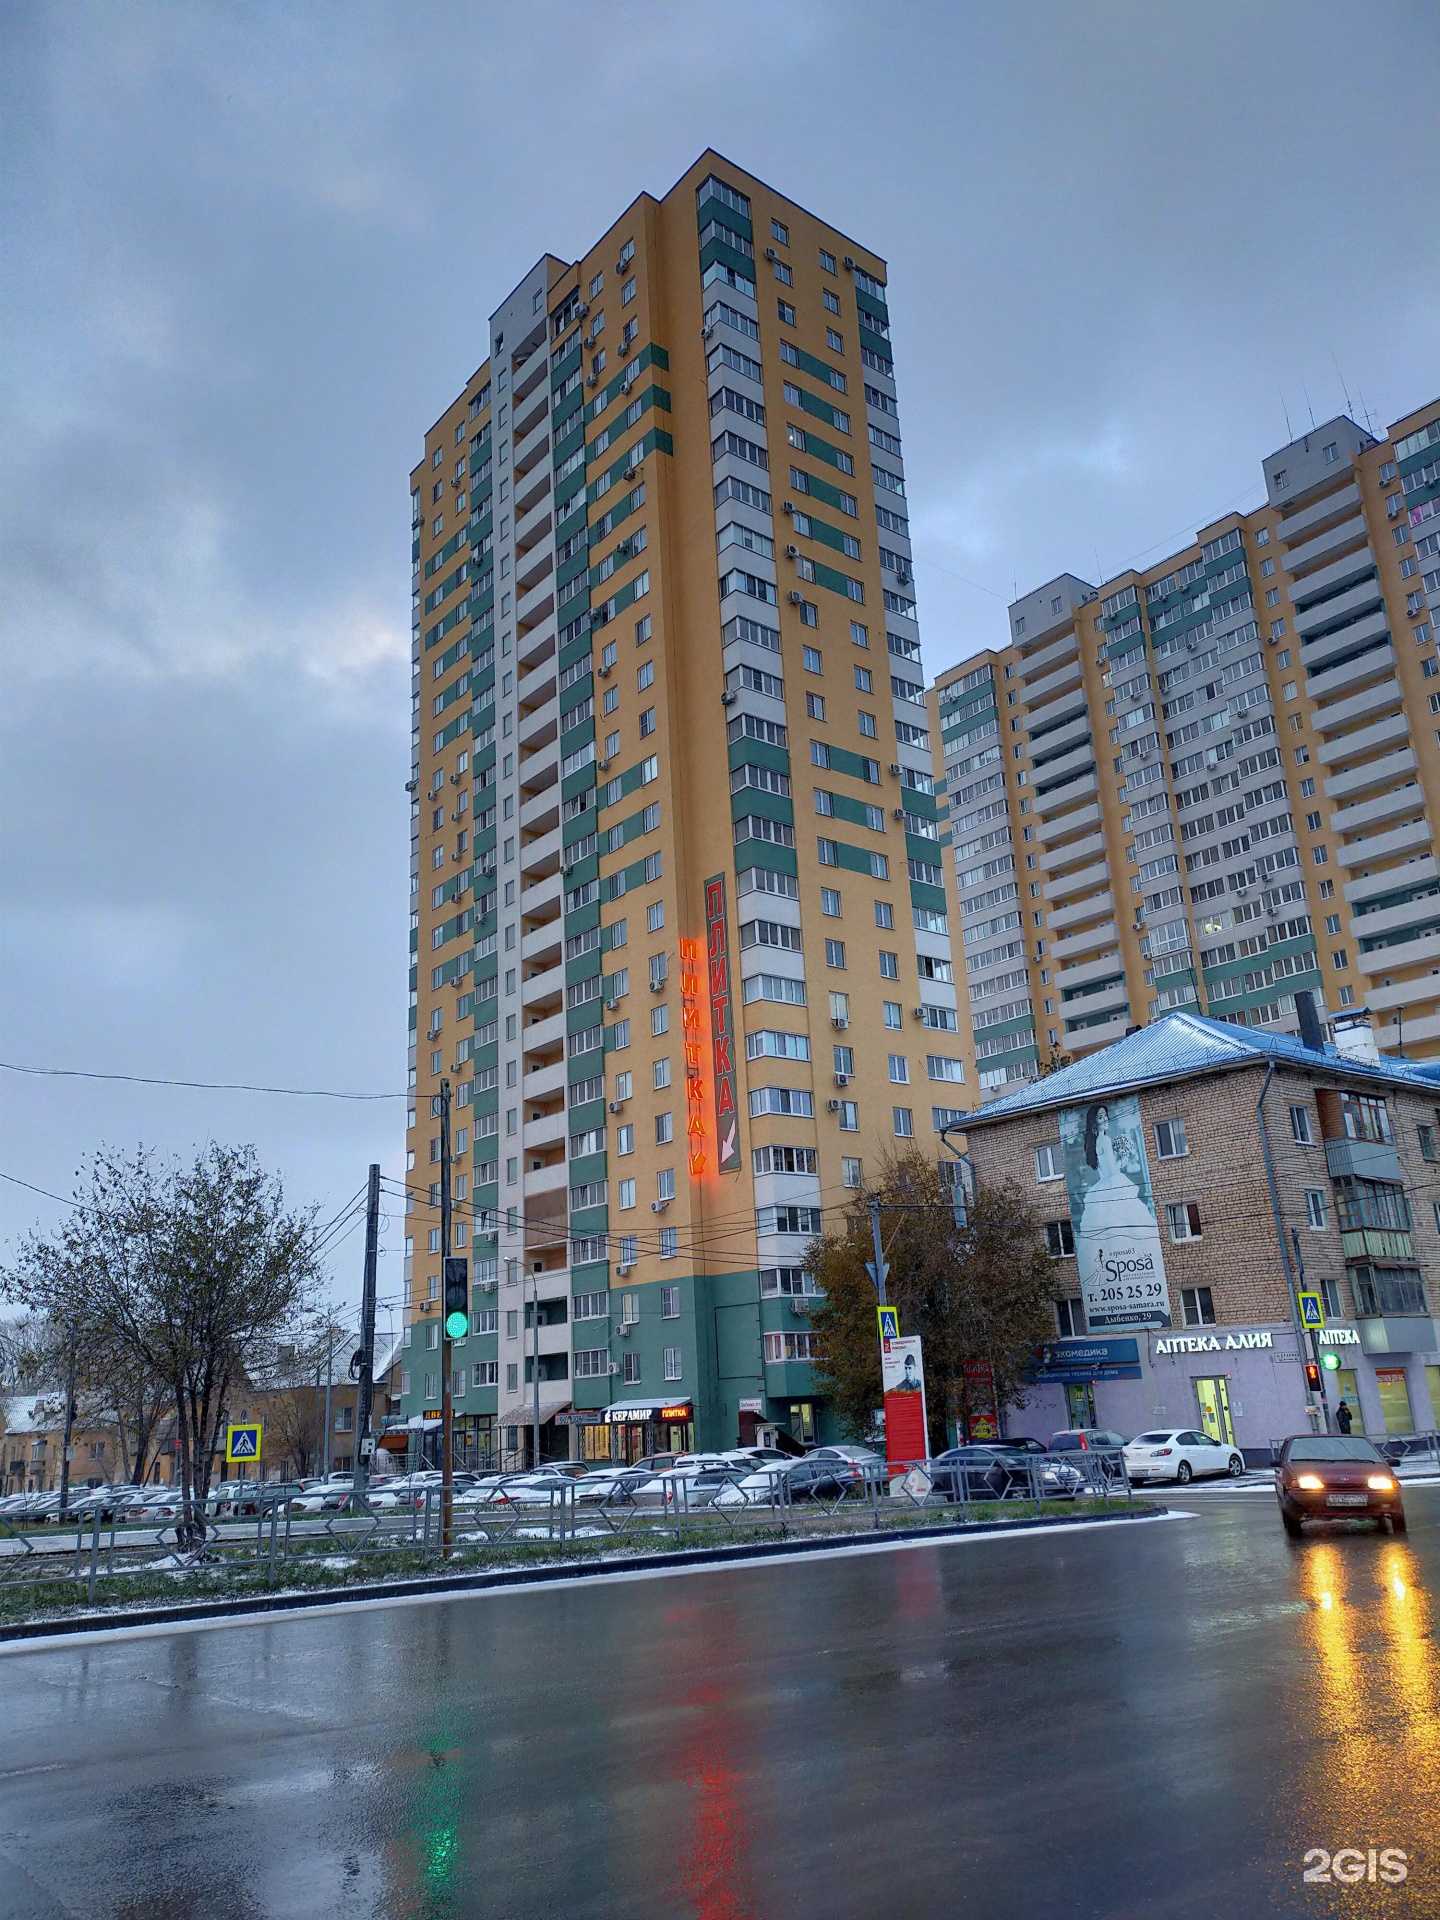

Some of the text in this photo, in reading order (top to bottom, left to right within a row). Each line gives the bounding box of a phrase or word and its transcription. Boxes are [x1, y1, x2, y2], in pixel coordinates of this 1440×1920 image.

[706, 880, 736, 1117] ПЛИТКА
[1105, 1257, 1154, 1282] Sposa
[1100, 1287, 1124, 1301] 205
[1126, 1285, 1143, 1299] 25
[1145, 1282, 1162, 1297] 29
[1089, 1301, 1165, 1313] www.sposa-samara.ru
[1142, 1312, 1152, 1321] 29
[1155, 1332, 1273, 1354] АПТЕКА АЛИЯ
[1319, 1329, 1361, 1345] АПТЕКА
[612, 1409, 653, 1422] КЕРАМИР
[661, 1408, 687, 1418] ПЛИТКА
